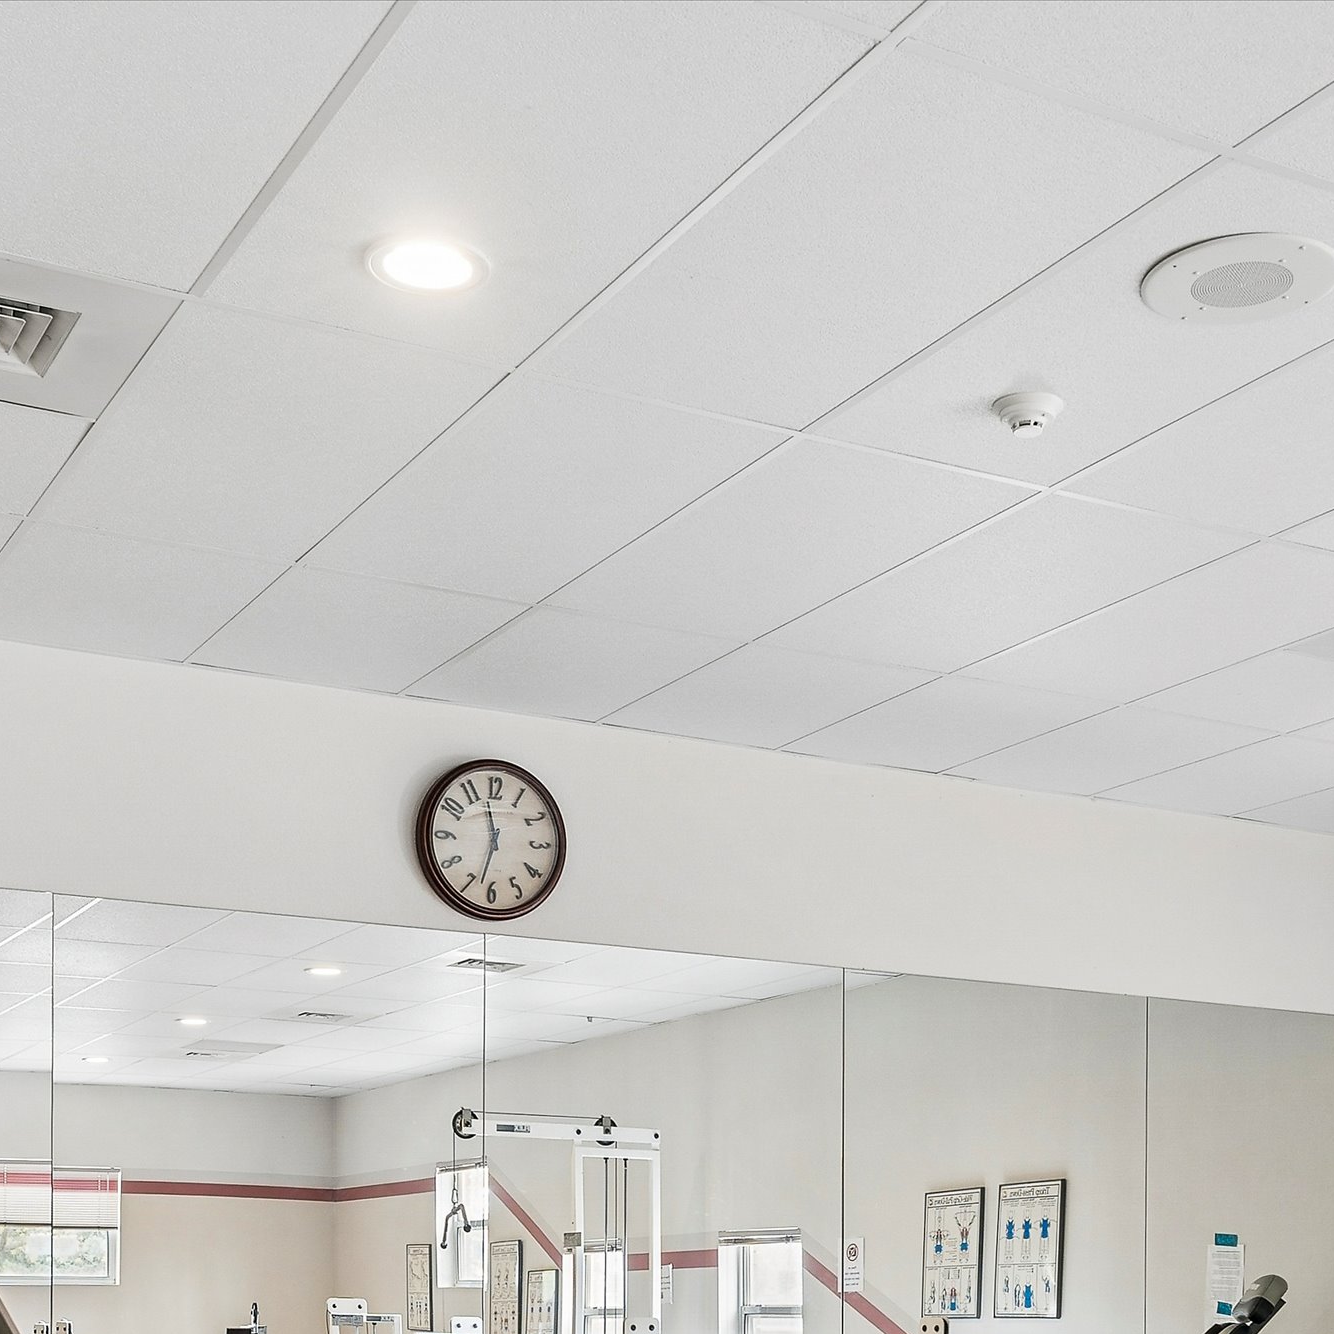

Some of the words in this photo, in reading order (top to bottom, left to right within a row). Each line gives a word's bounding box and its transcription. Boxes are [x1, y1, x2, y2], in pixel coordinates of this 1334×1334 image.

[460, 779, 482, 805] 11
[488, 777, 503, 800] 12
[511, 788, 526, 808] 1
[441, 798, 465, 821] 10
[524, 812, 546, 826] 2
[434, 830, 457, 840] 9
[530, 841, 551, 850] 3
[441, 855, 462, 869] 8
[523, 862, 543, 879] 4
[460, 873, 477, 893] 7
[486, 881, 496, 904] 6
[509, 877, 523, 900] 5
